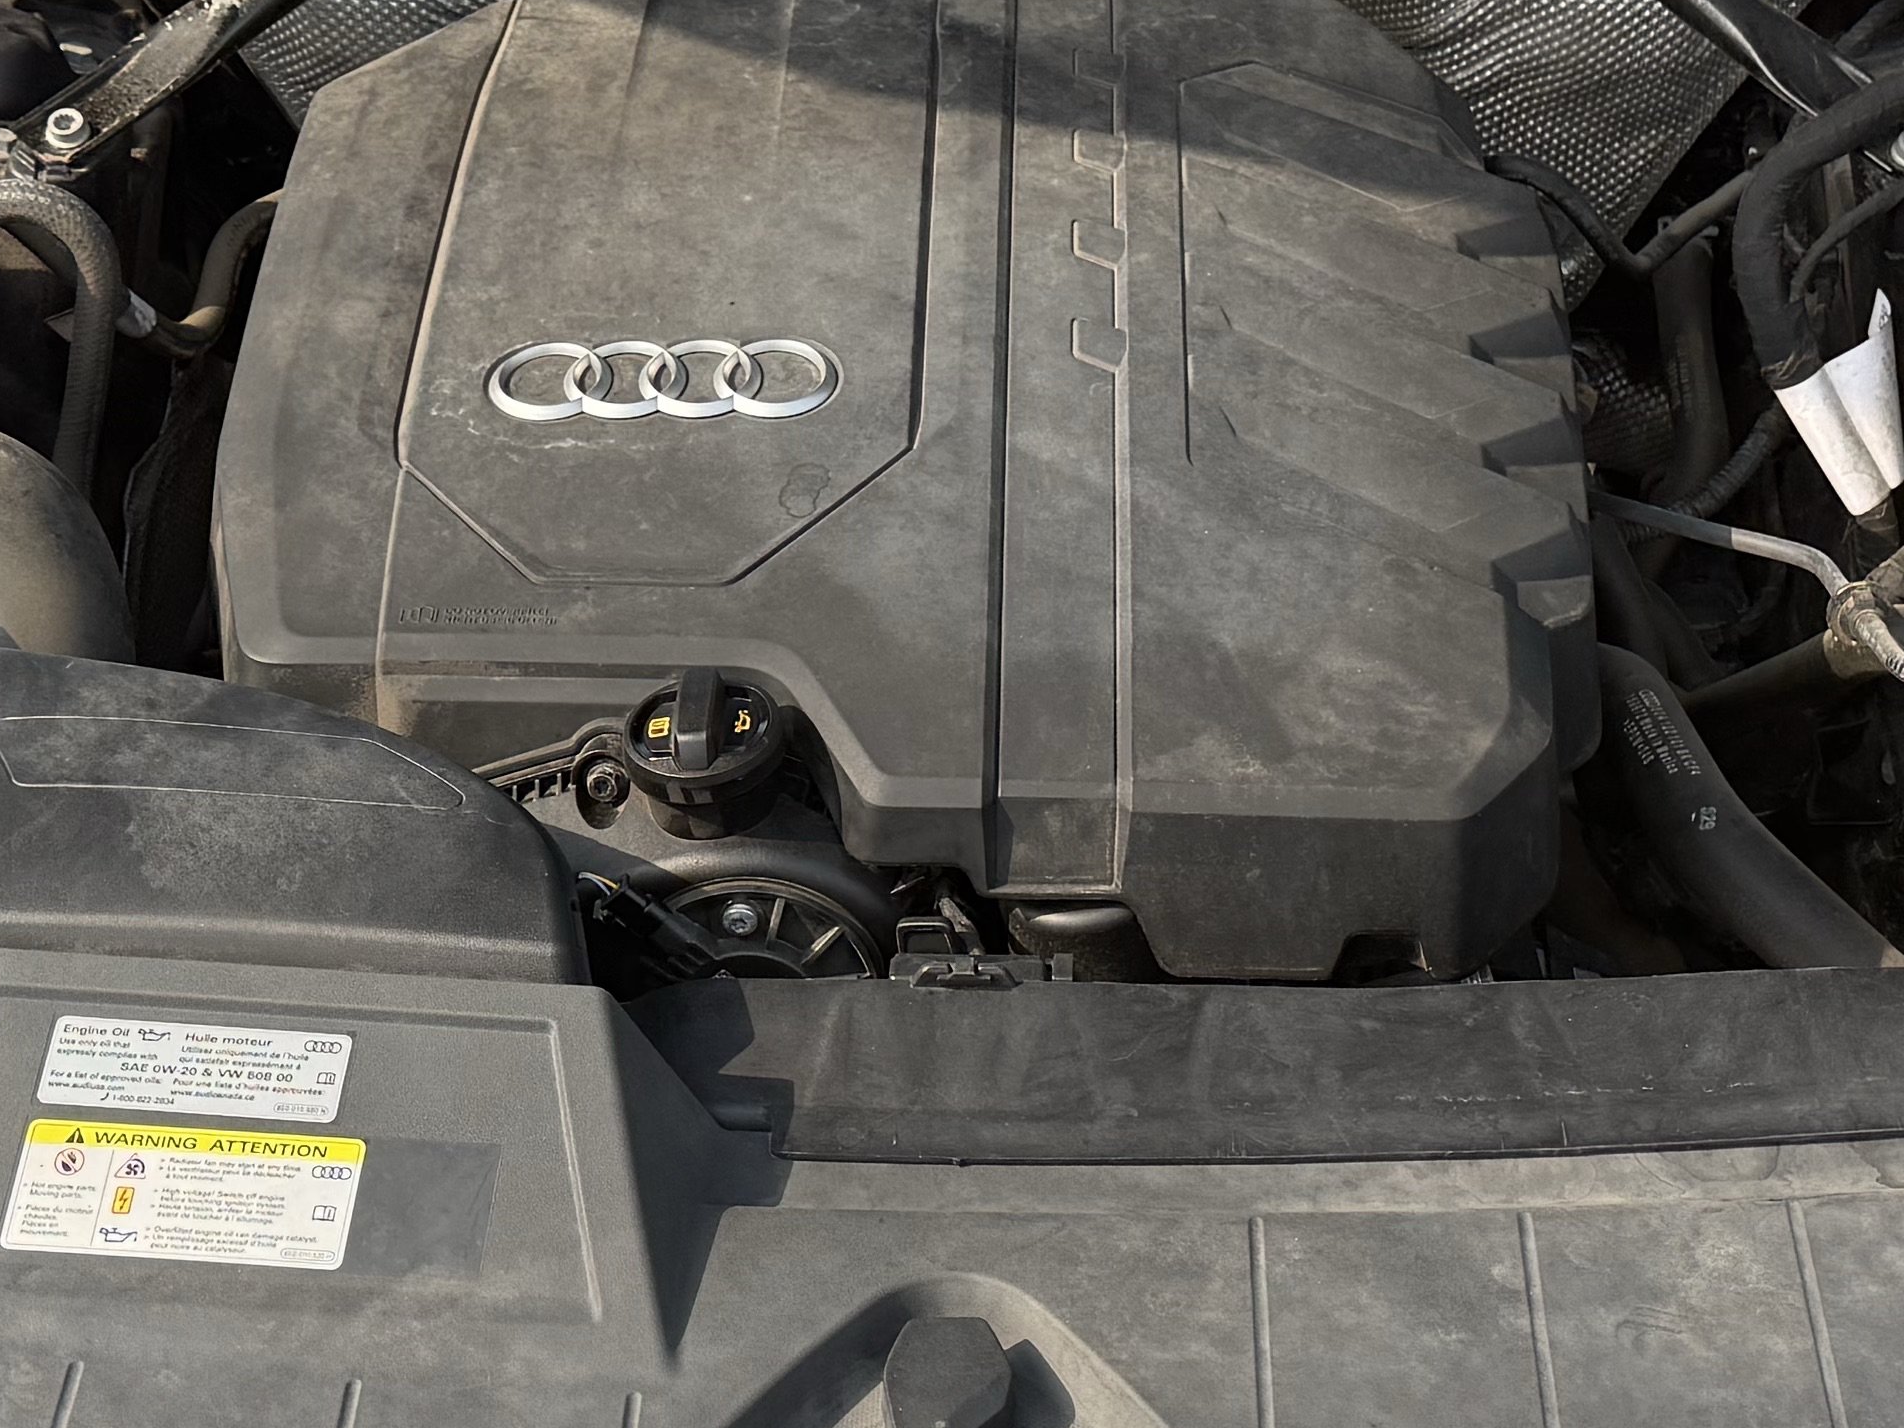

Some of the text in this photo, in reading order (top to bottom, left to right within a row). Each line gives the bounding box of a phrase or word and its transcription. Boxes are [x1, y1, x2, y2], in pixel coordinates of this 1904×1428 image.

[62, 1024, 130, 1037] Engine Oil
[77, 1038, 97, 1047] only
[99, 1039, 111, 1047] oil
[113, 1040, 130, 1048] that
[184, 1032, 273, 1046] Huile moteur
[139, 1052, 158, 1060] with
[50, 1069, 64, 1077] For
[120, 1062, 149, 1072] SAE
[152, 1064, 197, 1075] 0W-20
[200, 1067, 213, 1076] &
[217, 1068, 243, 1078] VW
[275, 1072, 293, 1082] 00
[172, 1078, 193, 1086] Pour
[93, 1131, 327, 1157] WARNING ATTENTION
